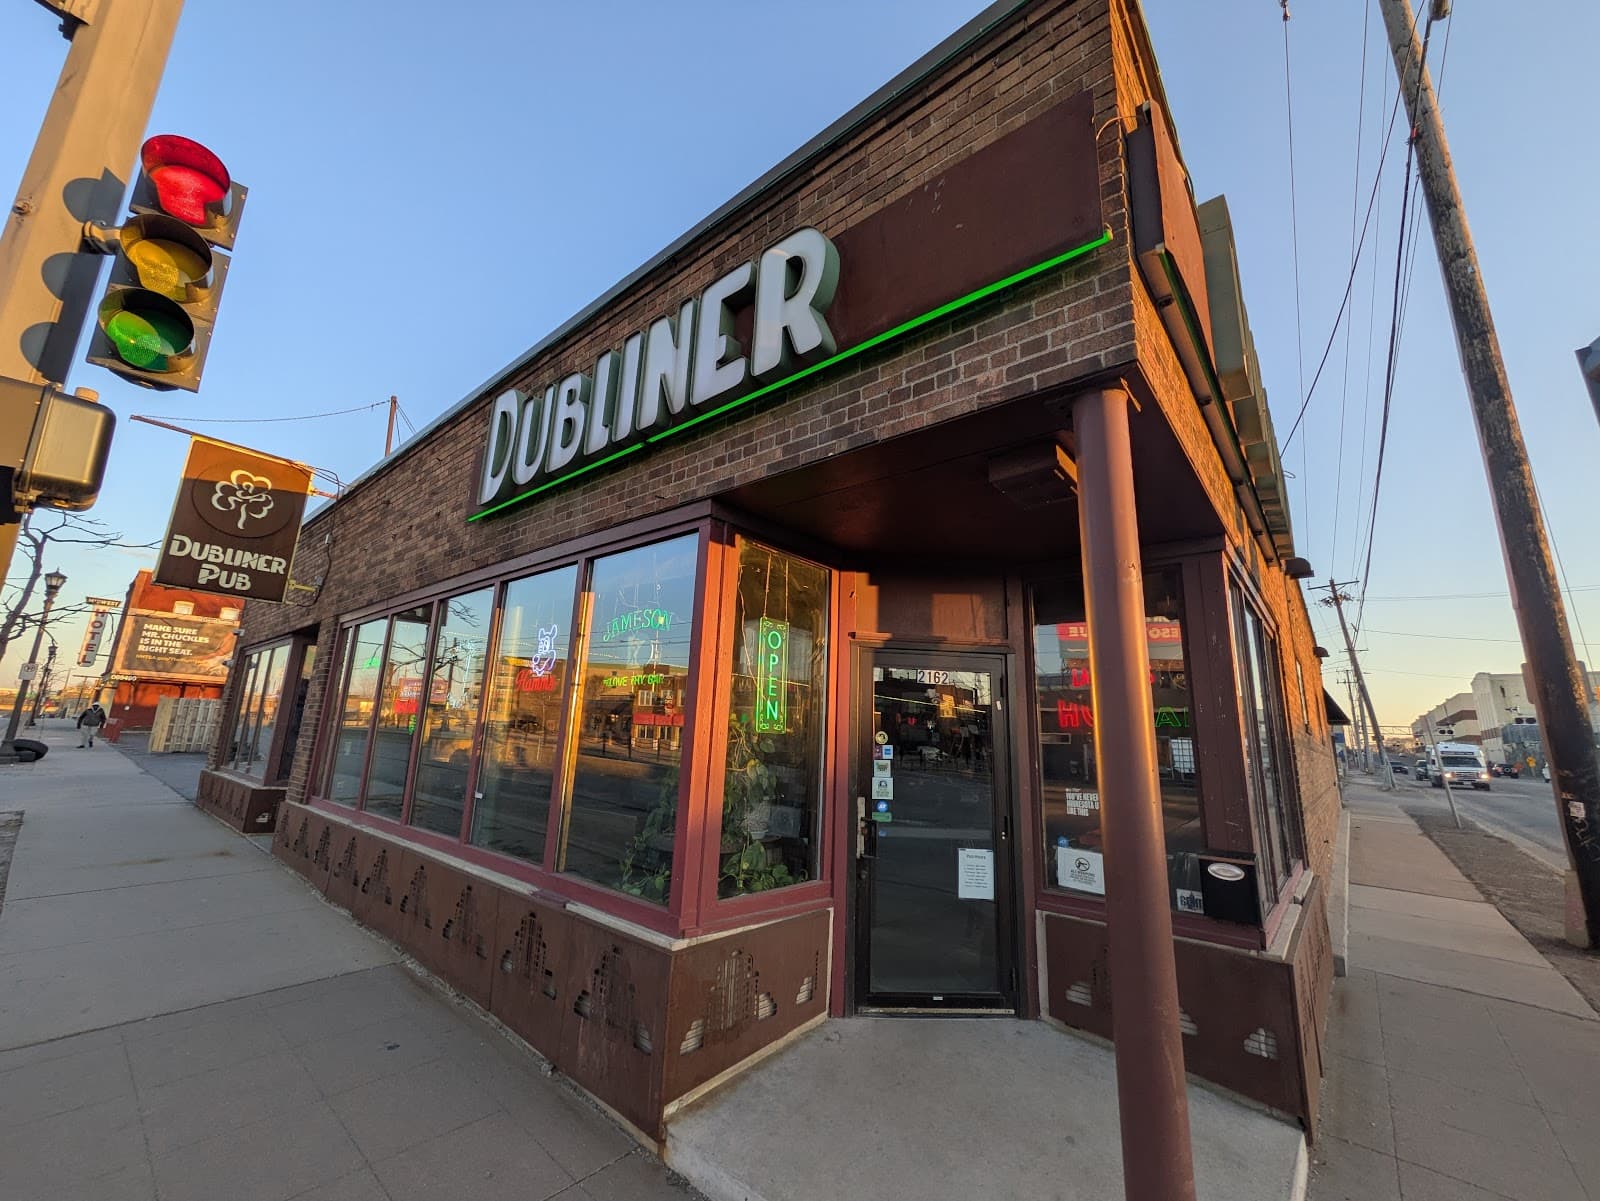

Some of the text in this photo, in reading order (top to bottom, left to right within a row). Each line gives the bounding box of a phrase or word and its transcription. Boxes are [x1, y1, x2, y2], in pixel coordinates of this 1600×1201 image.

[477, 226, 839, 506] DUBLINER
[169, 534, 287, 575] DUBLINER
[198, 563, 252, 591] PUB
[81, 608, 107, 665] HOTEL
[141, 630, 210, 644] MR. CHUCKLES
[143, 623, 199, 636] MAKE SURE
[603, 609, 673, 642] JAMESON
[137, 645, 193, 656] RIGHT SEAT.
[139, 637, 183, 648] IS IN THE
[767, 631, 782, 721] OPEN
[918, 670, 949, 684] 2162
